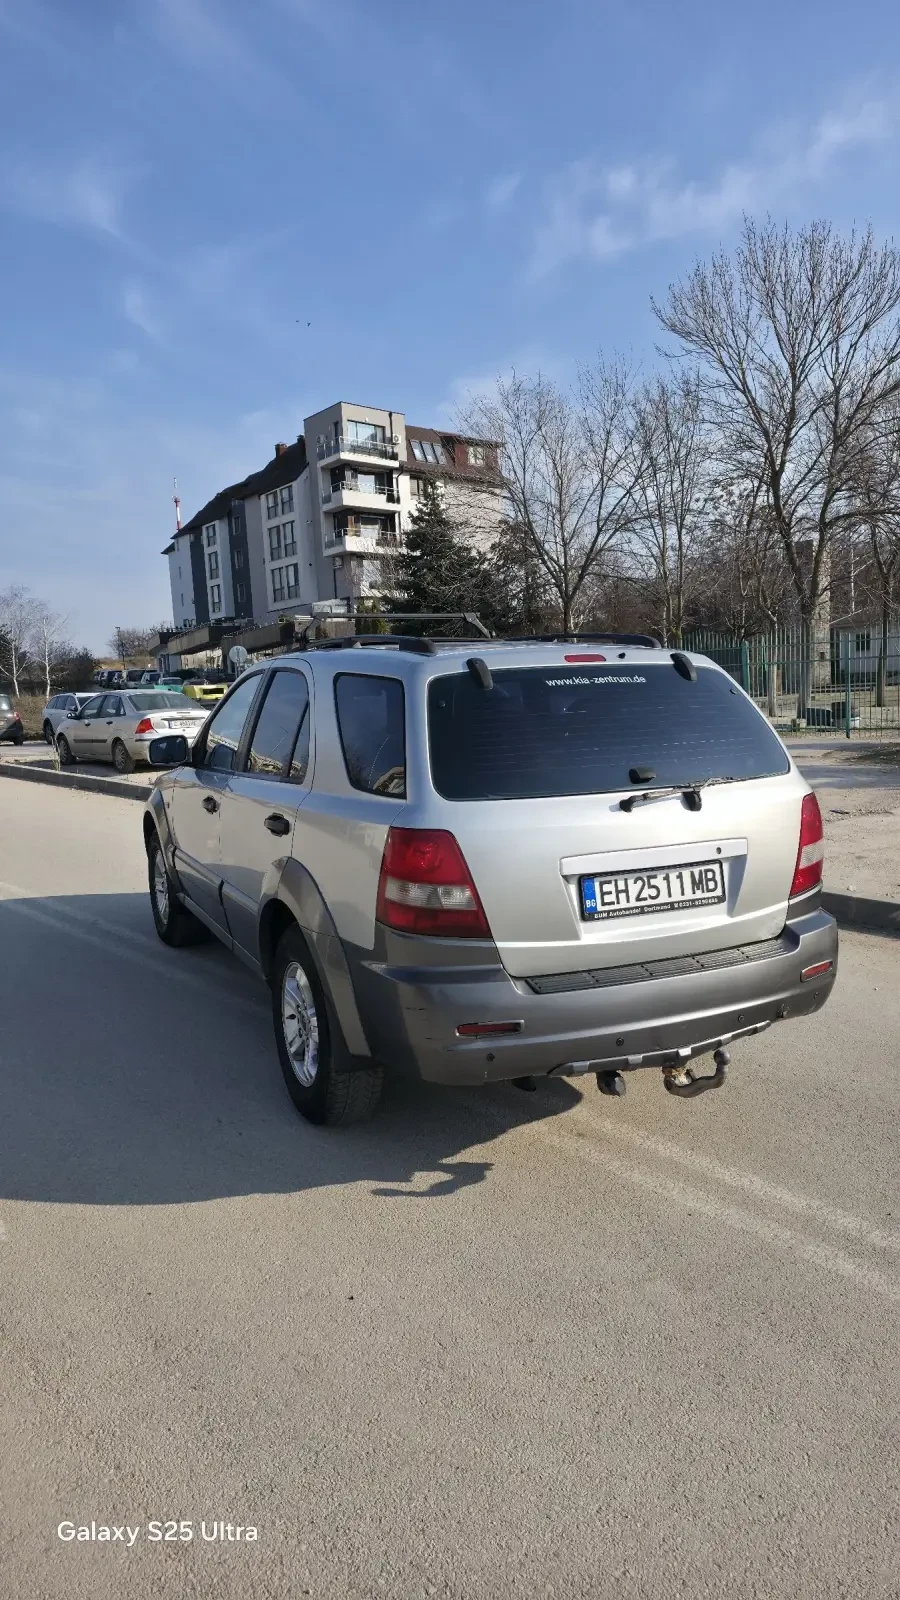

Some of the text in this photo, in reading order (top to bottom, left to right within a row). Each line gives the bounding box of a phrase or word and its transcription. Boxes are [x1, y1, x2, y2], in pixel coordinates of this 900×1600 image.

[545, 675, 647, 686] www.kia-zentrum.de
[585, 898, 596, 908] BG
[609, 907, 641, 917] Autohandel
[643, 904, 671, 912] Dortmund
